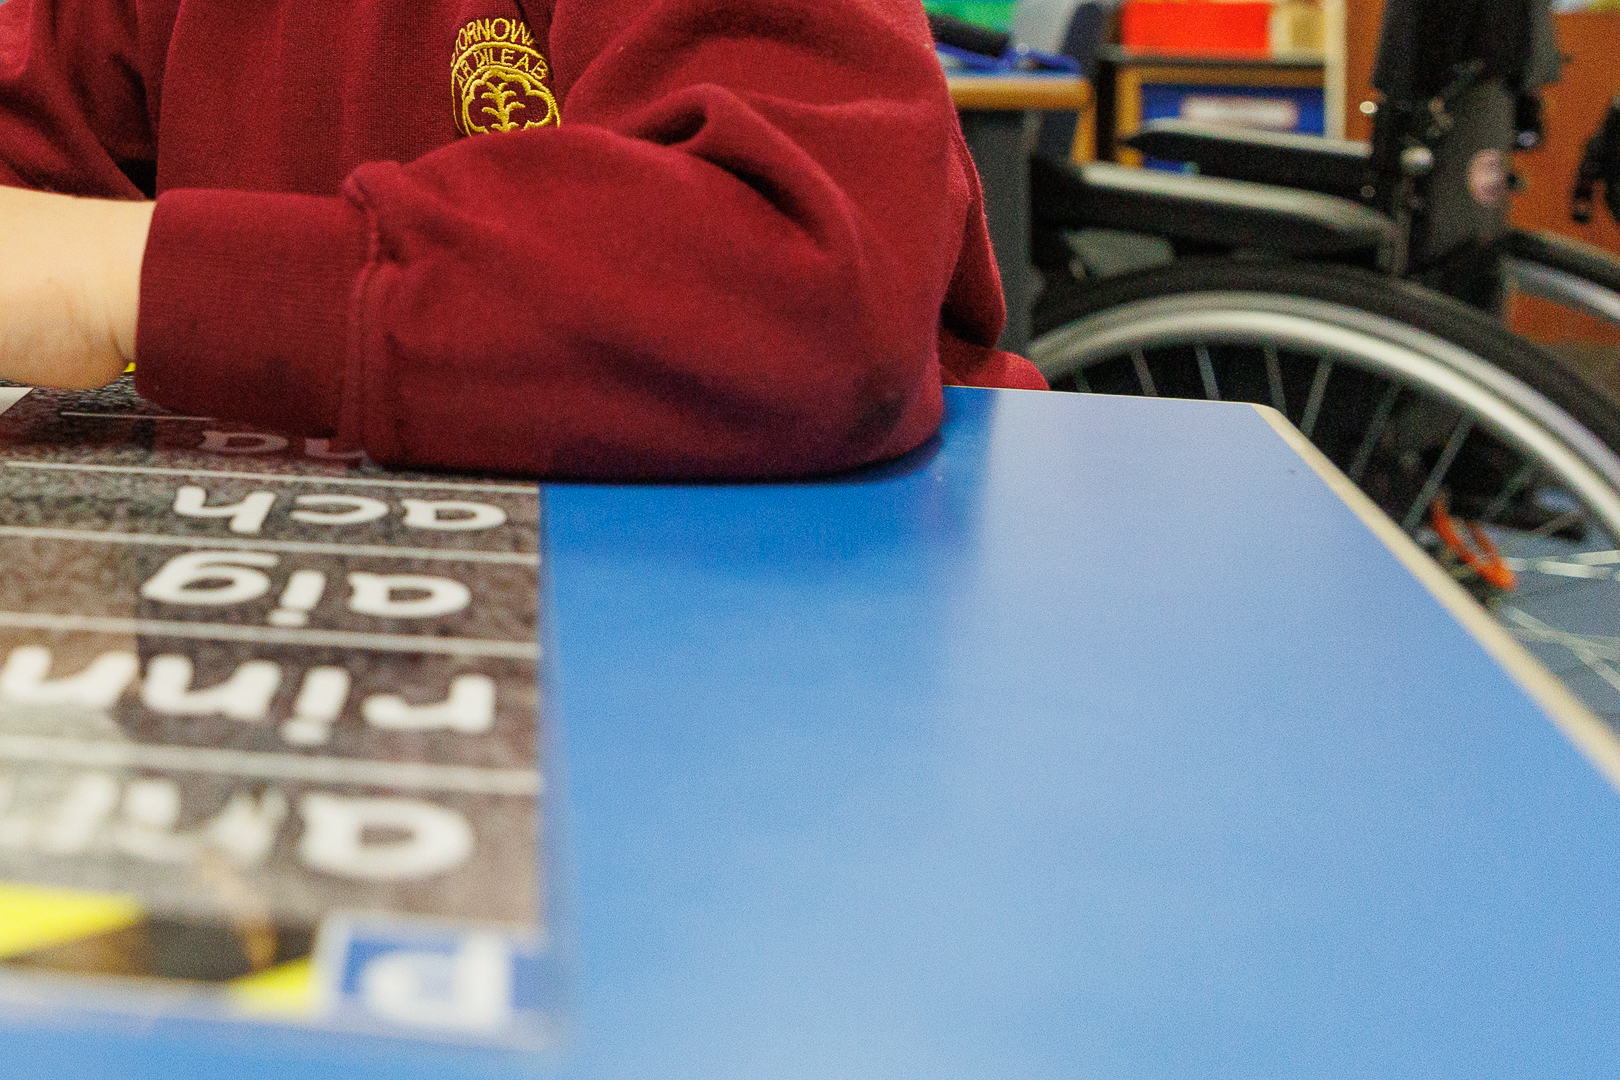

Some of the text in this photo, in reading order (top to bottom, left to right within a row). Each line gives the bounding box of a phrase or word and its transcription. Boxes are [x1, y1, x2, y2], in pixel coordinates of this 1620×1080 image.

[173, 485, 507, 534] ach
[141, 550, 471, 626] aig
[360, 932, 512, 1030] P
